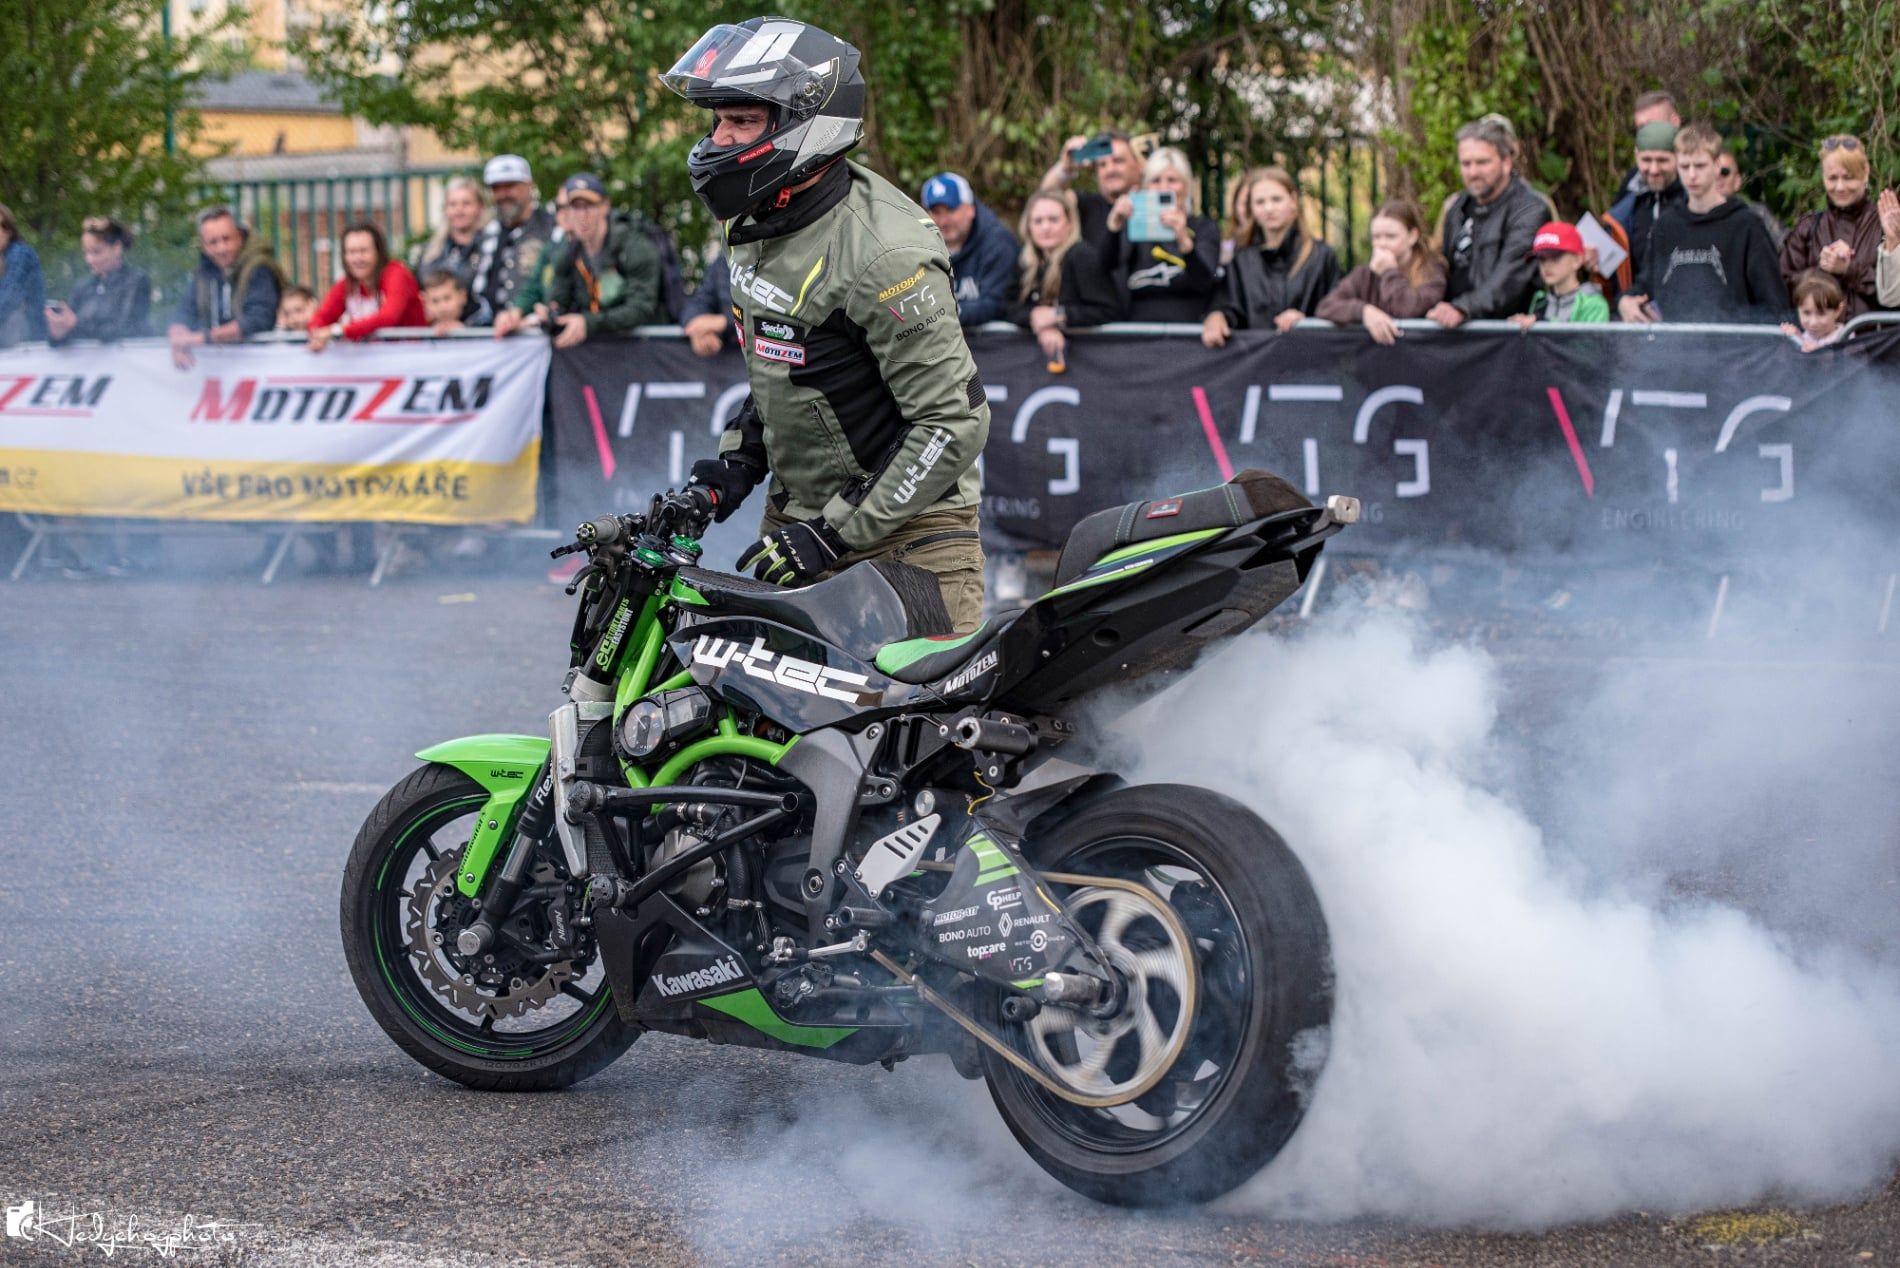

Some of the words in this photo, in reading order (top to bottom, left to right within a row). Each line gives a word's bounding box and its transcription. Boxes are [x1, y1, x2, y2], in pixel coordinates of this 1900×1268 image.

[895, 323, 925, 342] BONO
[926, 308, 946, 327] AUTO
[1546, 386, 1794, 504] VTG
[239, 473, 293, 499] PRO
[1002, 891, 1022, 904] HELP
[1014, 914, 1051, 927] RENAULT
[939, 930, 965, 943] BONO
[966, 925, 991, 938] AUTO
[967, 942, 1007, 960] topcare
[652, 955, 745, 997] Kawasaki
